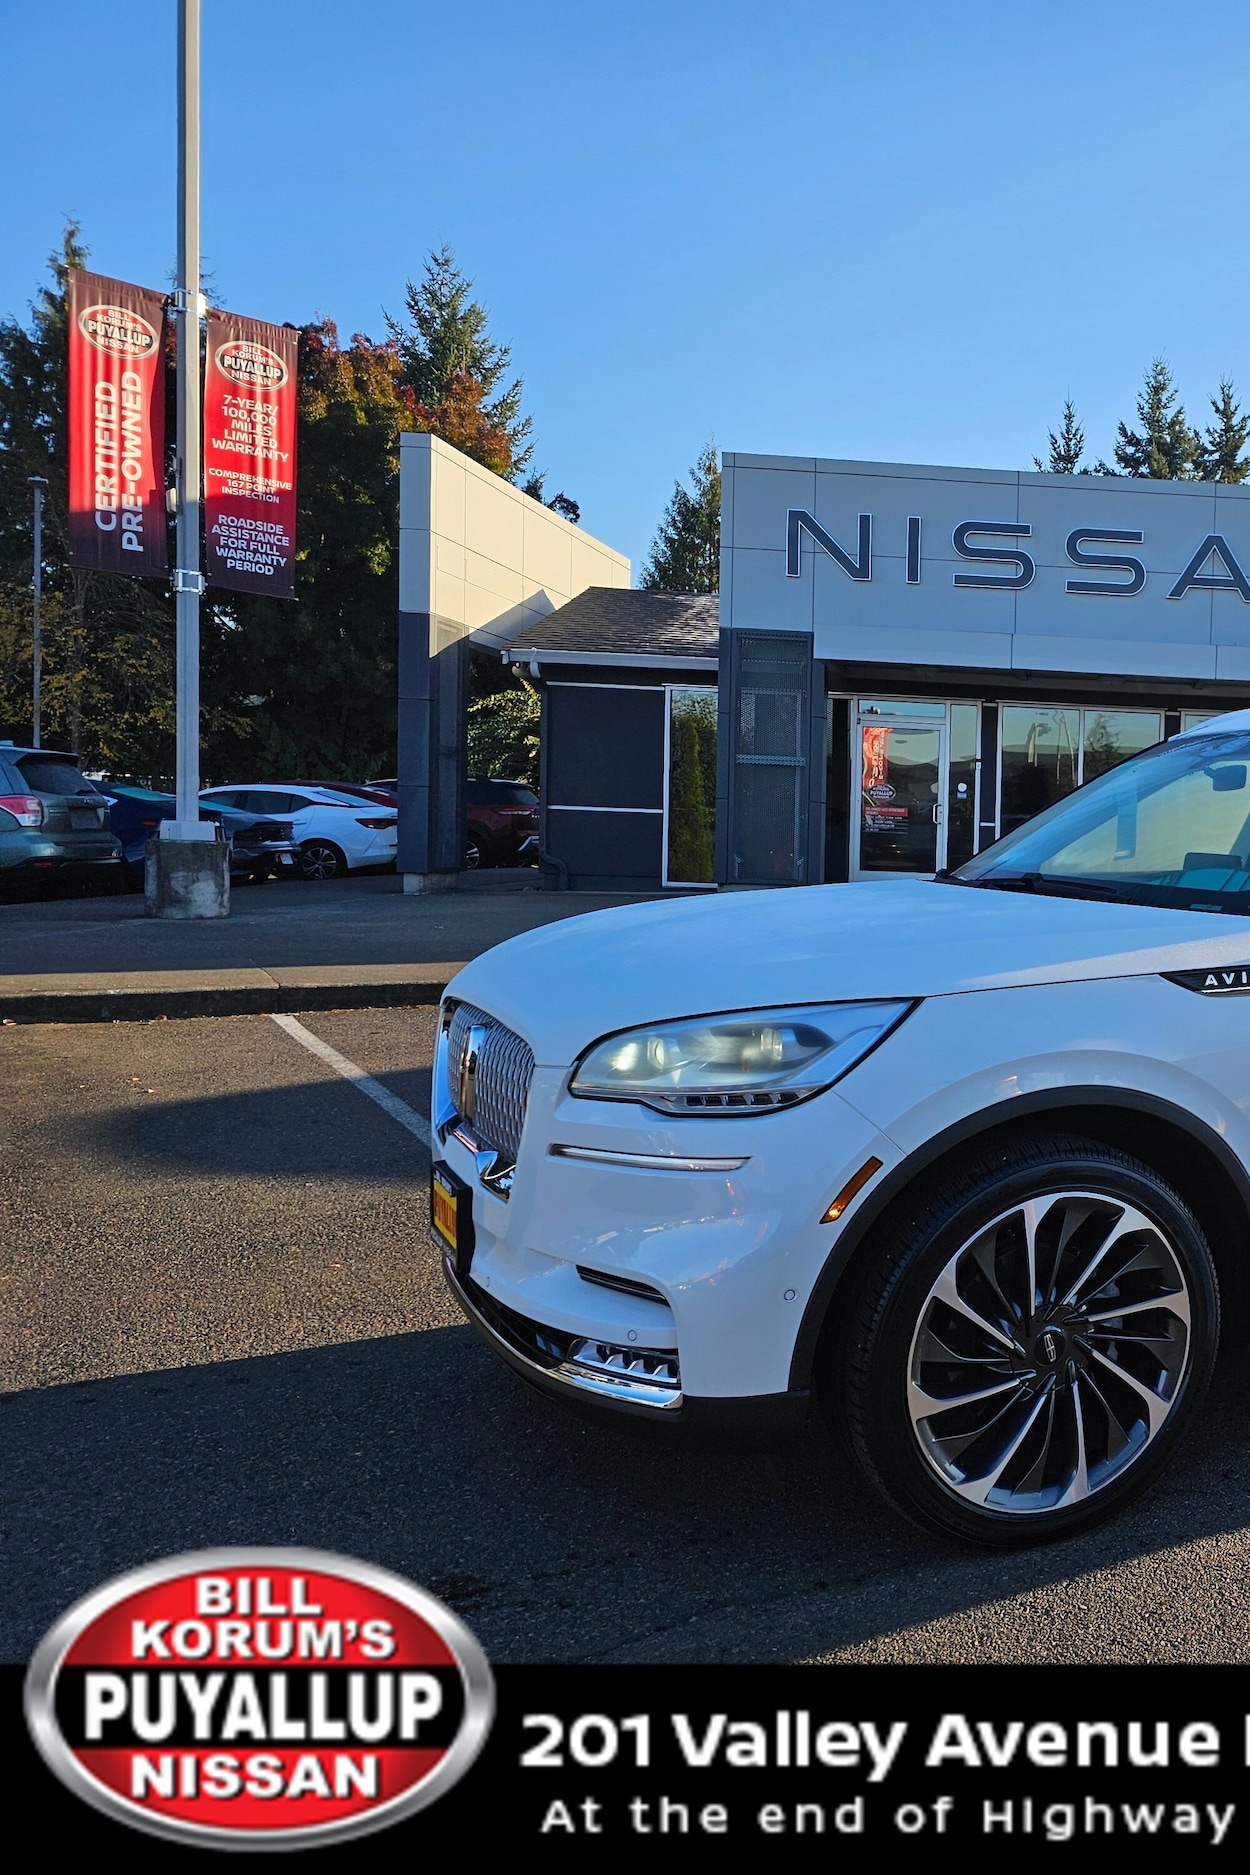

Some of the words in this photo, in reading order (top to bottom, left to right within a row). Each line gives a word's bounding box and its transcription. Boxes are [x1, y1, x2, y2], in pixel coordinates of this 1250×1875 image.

[96, 313, 142, 332] KORUM'S
[108, 310, 130, 320] BILL
[88, 320, 151, 347] PUYALLUP
[96, 335, 140, 353] NISSAN
[242, 345, 262, 355] BILL
[223, 355, 281, 379] PUYALLUP
[232, 349, 274, 366] KORUM'S
[231, 370, 272, 386] NISSAN
[223, 395, 279, 416] 7-YEAR/
[221, 406, 277, 426] 100,000
[231, 420, 272, 436] MILES
[224, 429, 278, 449] LIMITED
[95, 380, 117, 531] CERTIFIED
[211, 438, 289, 463] WARRANTY
[121, 371, 143, 552] PRE-OWNED
[208, 468, 292, 490] COMPREHENSIVE
[227, 479, 244, 488] 167
[246, 482, 276, 494] POINT
[221, 486, 279, 503] INSPECTION
[218, 514, 284, 535] ROADSIDE
[211, 525, 290, 546] ASSISTANCE
[220, 536, 247, 549] FOR
[250, 542, 280, 555] FULL
[215, 546, 287, 567] WARRANTY
[227, 559, 274, 575] PERIOD
